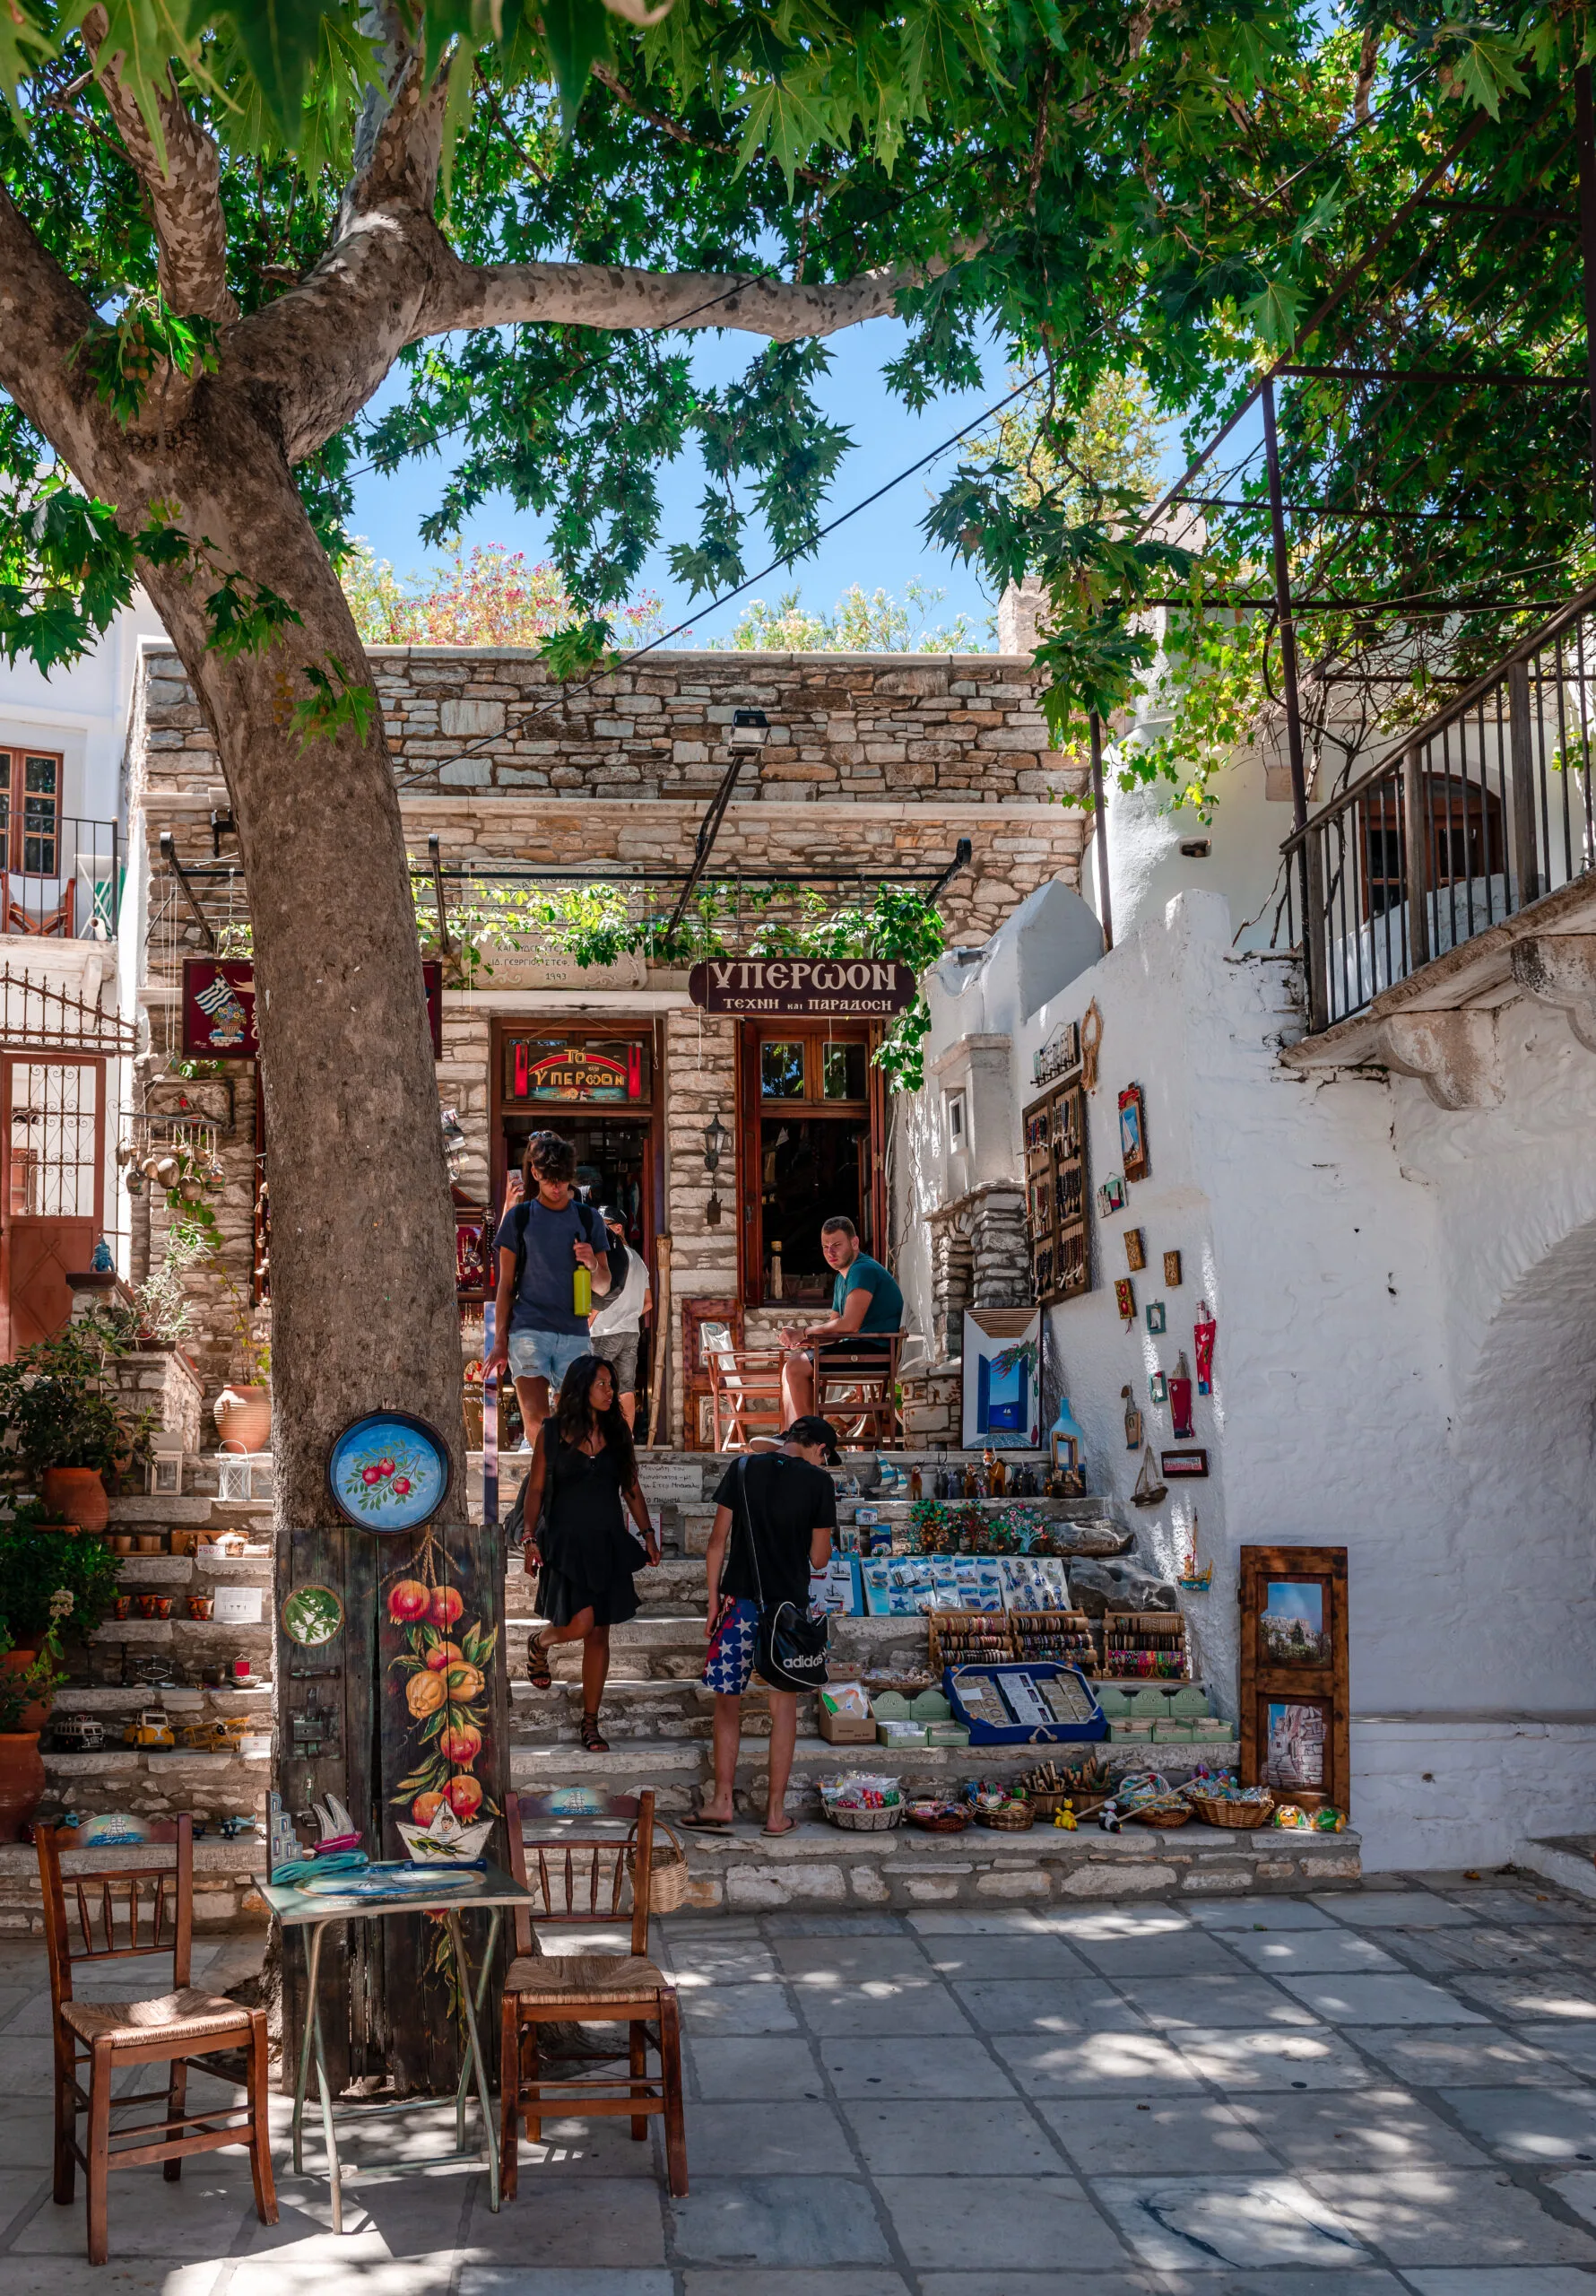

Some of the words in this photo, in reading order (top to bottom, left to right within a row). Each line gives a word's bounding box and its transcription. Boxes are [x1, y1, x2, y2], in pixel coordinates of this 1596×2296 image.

[545, 972, 567, 980] 1993
[709, 961, 898, 991] ΥΠΕΡΩΟΝ
[723, 997, 780, 1010] ΤΕΧΝΗ
[783, 1654, 824, 1669] adidas
